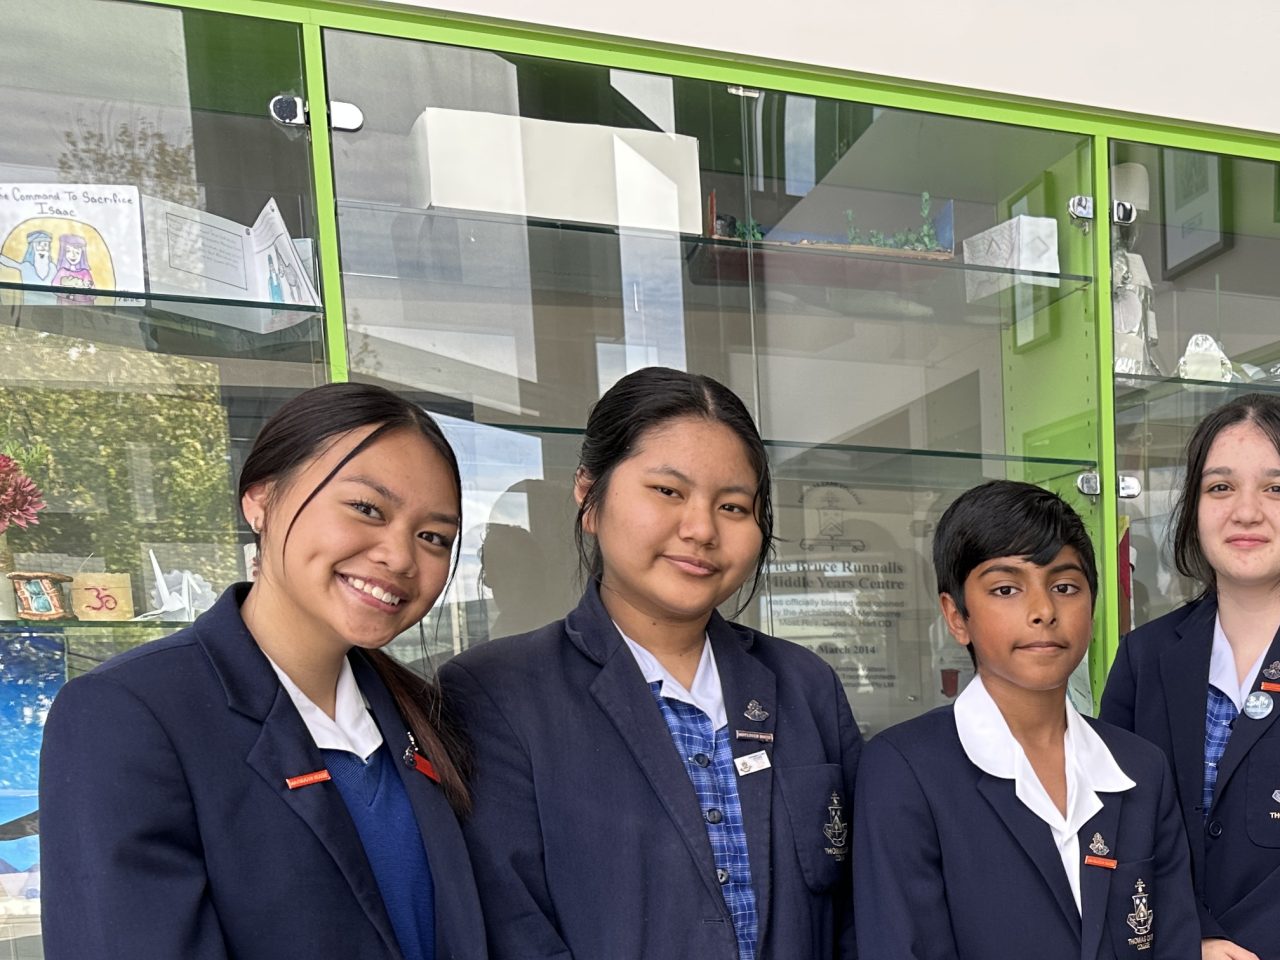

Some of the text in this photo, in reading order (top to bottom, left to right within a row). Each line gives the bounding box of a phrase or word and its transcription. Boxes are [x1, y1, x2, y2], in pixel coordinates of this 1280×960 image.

[11, 186, 60, 202] Command
[64, 191, 78, 200] To
[82, 191, 134, 205] Sacrifice
[34, 202, 76, 216] Isaac
[797, 561, 841, 573] Bruce
[842, 561, 904, 574] Runnalls
[819, 577, 855, 589] Years
[859, 577, 905, 590] Centre
[818, 644, 850, 655] March
[853, 645, 876, 655] 2014
